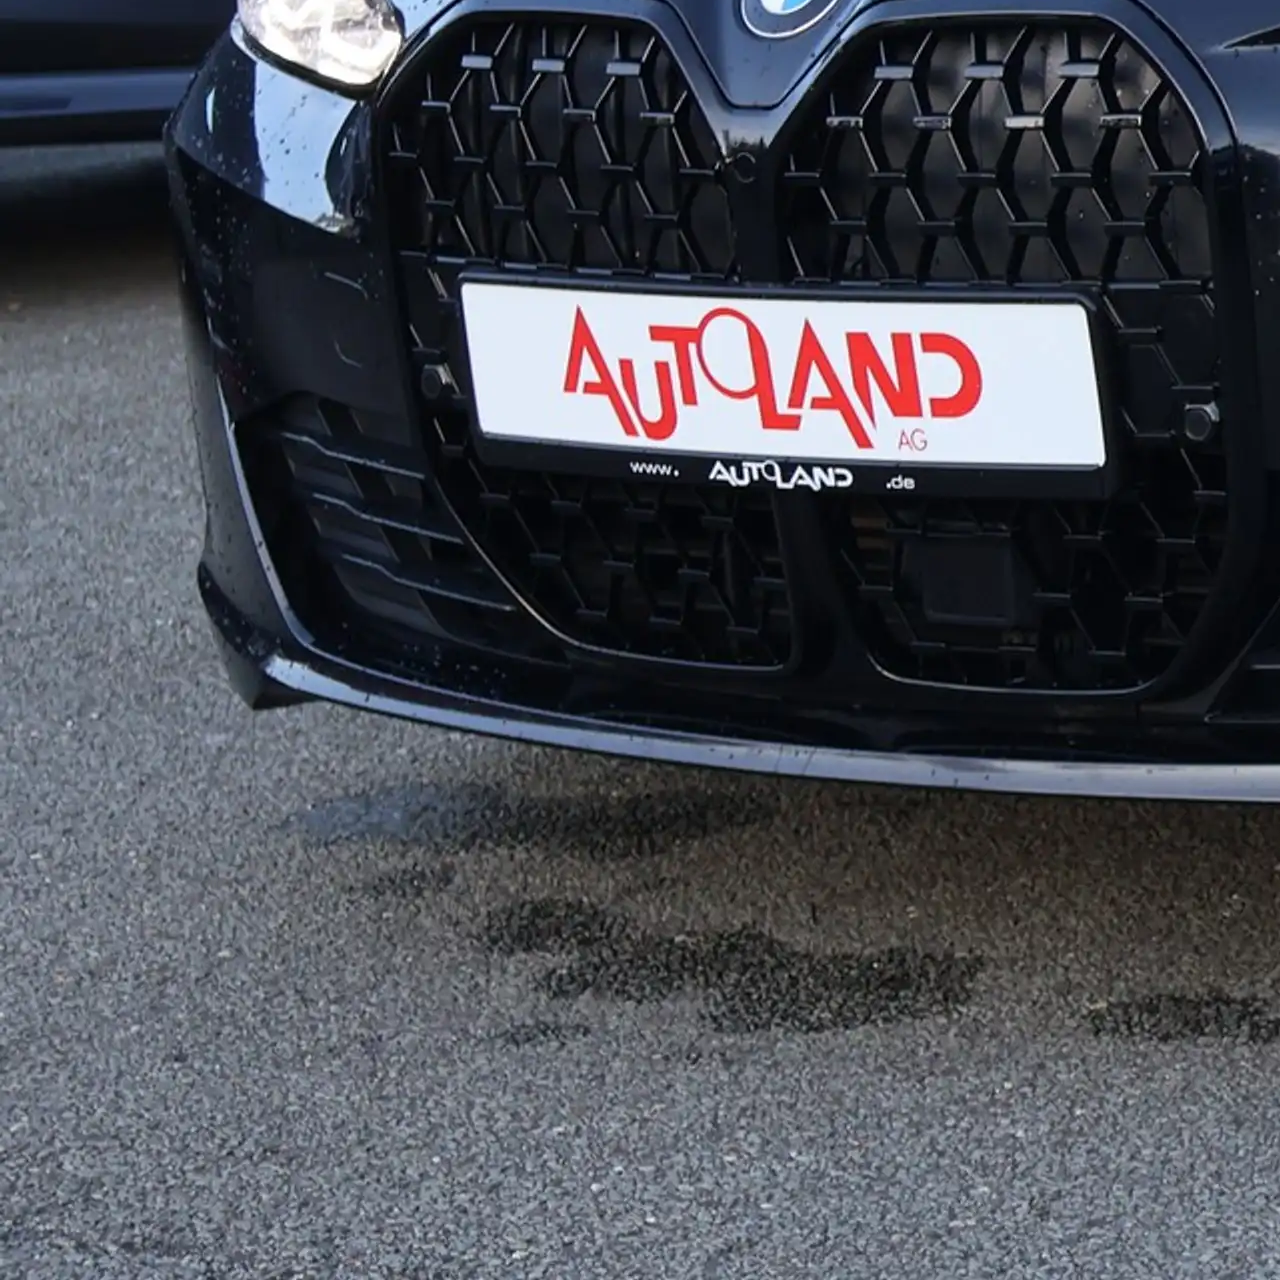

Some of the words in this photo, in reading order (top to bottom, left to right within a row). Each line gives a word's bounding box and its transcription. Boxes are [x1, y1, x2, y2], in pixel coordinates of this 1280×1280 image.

[563, 305, 983, 448] AUTOLAND
[897, 428, 929, 452] AG
[629, 461, 680, 478] www.
[708, 459, 853, 491] AUTOLAND
[885, 474, 916, 491] .de
